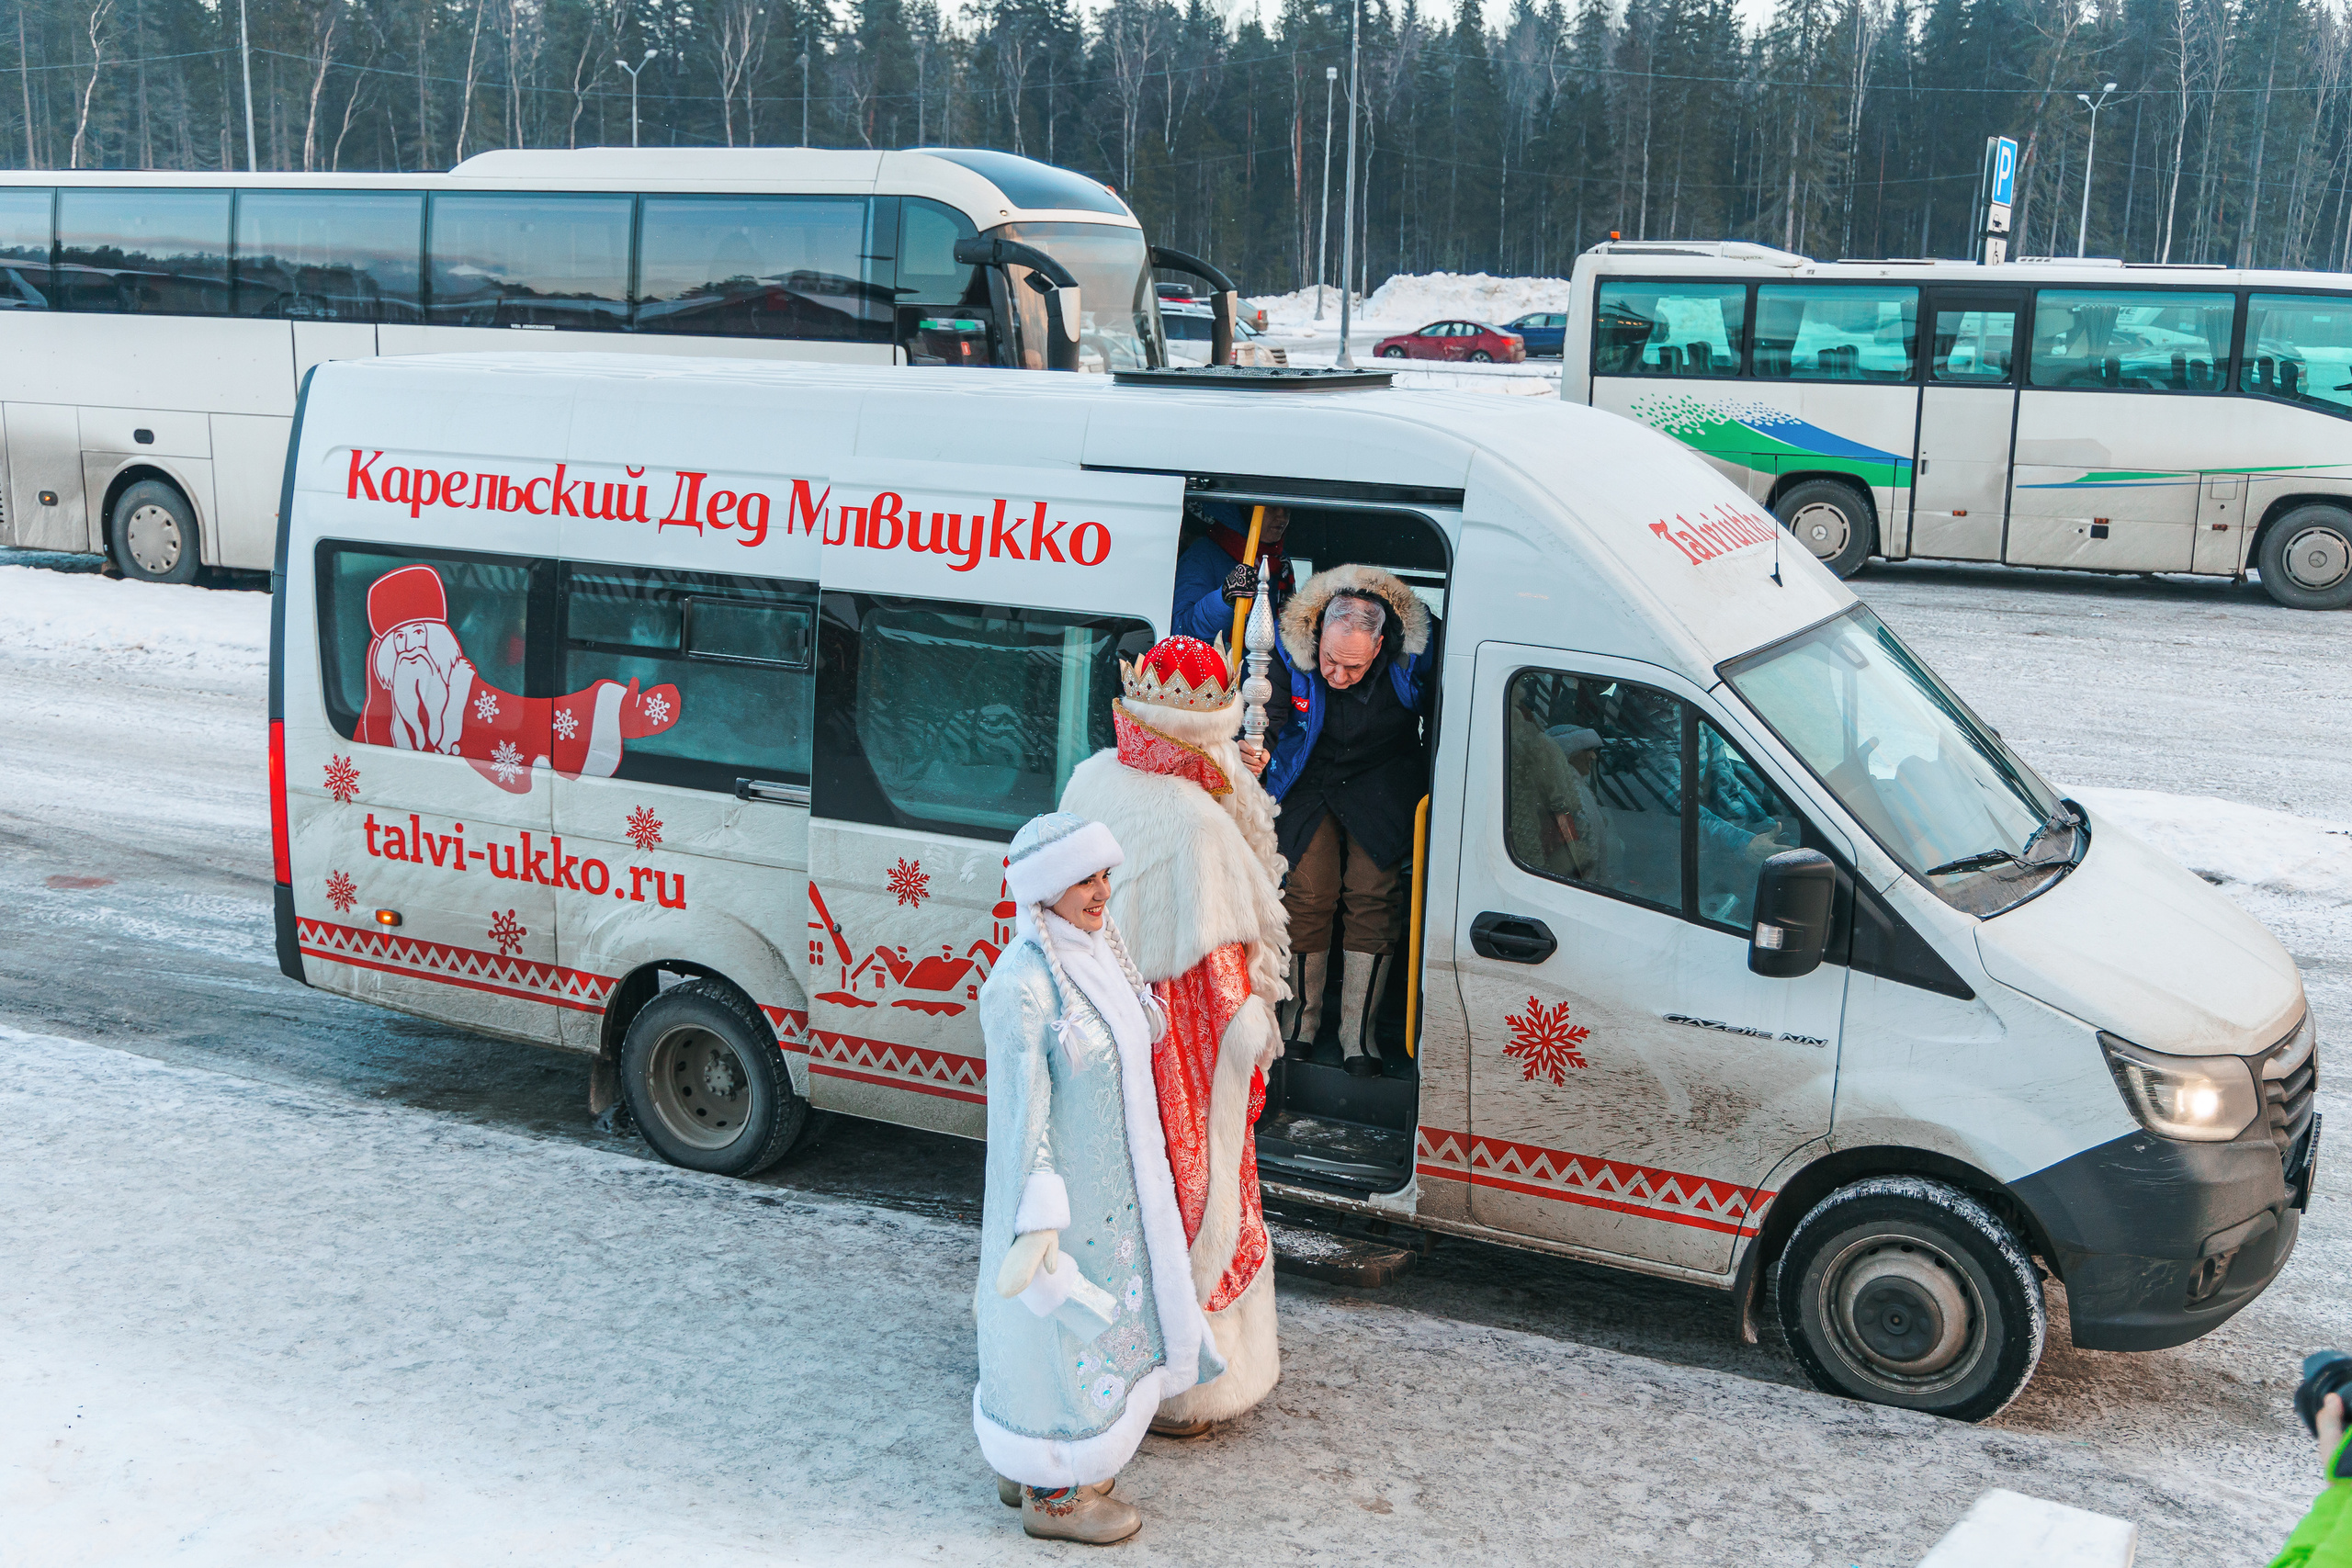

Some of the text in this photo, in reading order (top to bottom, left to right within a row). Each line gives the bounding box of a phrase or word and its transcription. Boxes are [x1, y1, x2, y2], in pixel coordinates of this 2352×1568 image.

[1996, 145, 2012, 197] P
[347, 449, 650, 524] Карельский
[658, 470, 771, 547] Дед
[1648, 502, 1781, 566] Talviukko
[364, 813, 687, 910] talvi-ukko.ru
[1662, 1012, 1829, 1049] GAZelle NN
